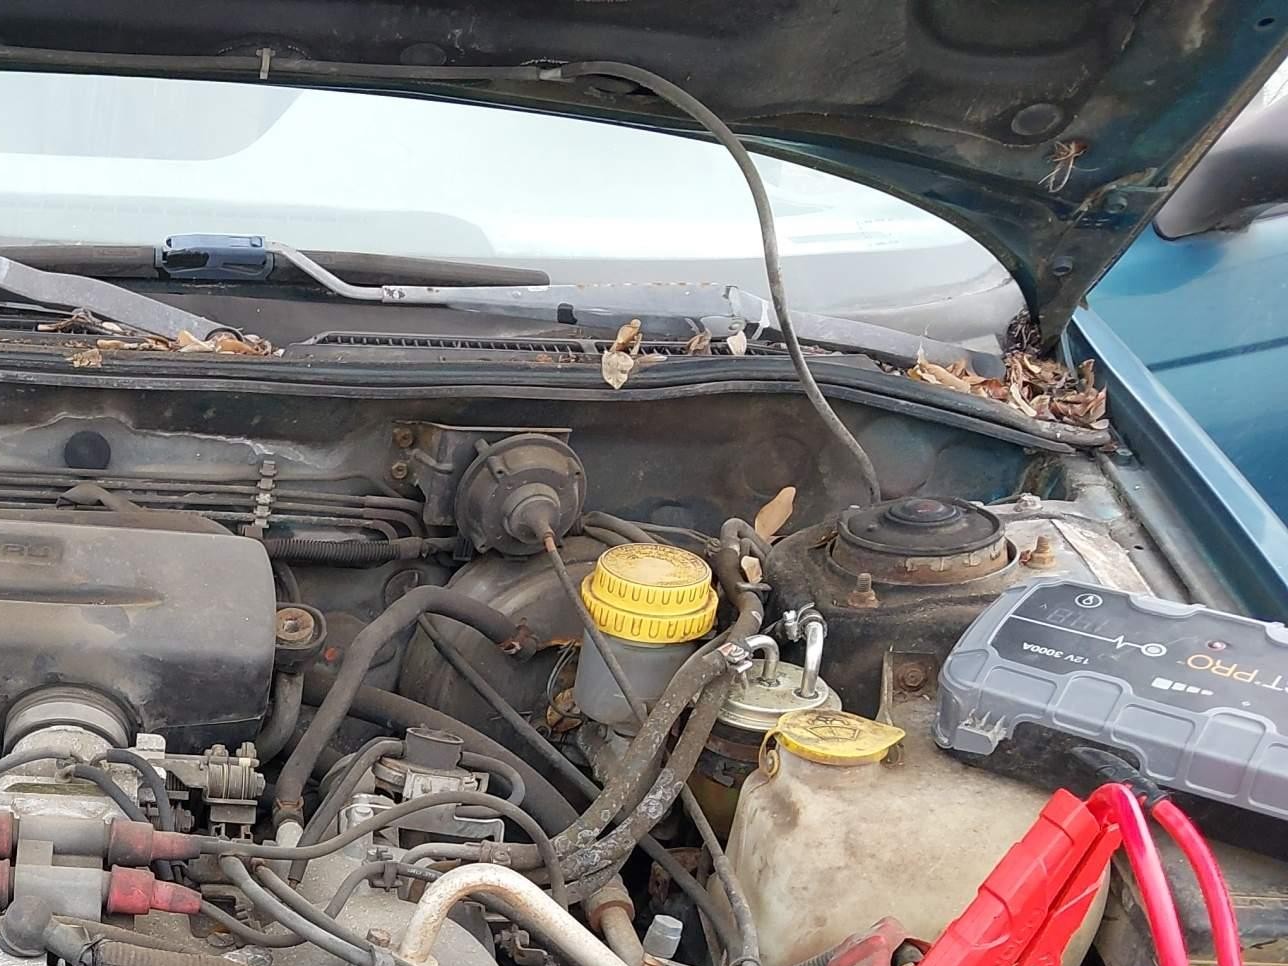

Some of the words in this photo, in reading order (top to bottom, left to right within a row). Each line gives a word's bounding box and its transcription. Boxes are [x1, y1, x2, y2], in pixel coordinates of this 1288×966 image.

[1023, 642, 1064, 658] 3000A
[1064, 654, 1089, 664] 12V
[1187, 654, 1259, 683] PRO
